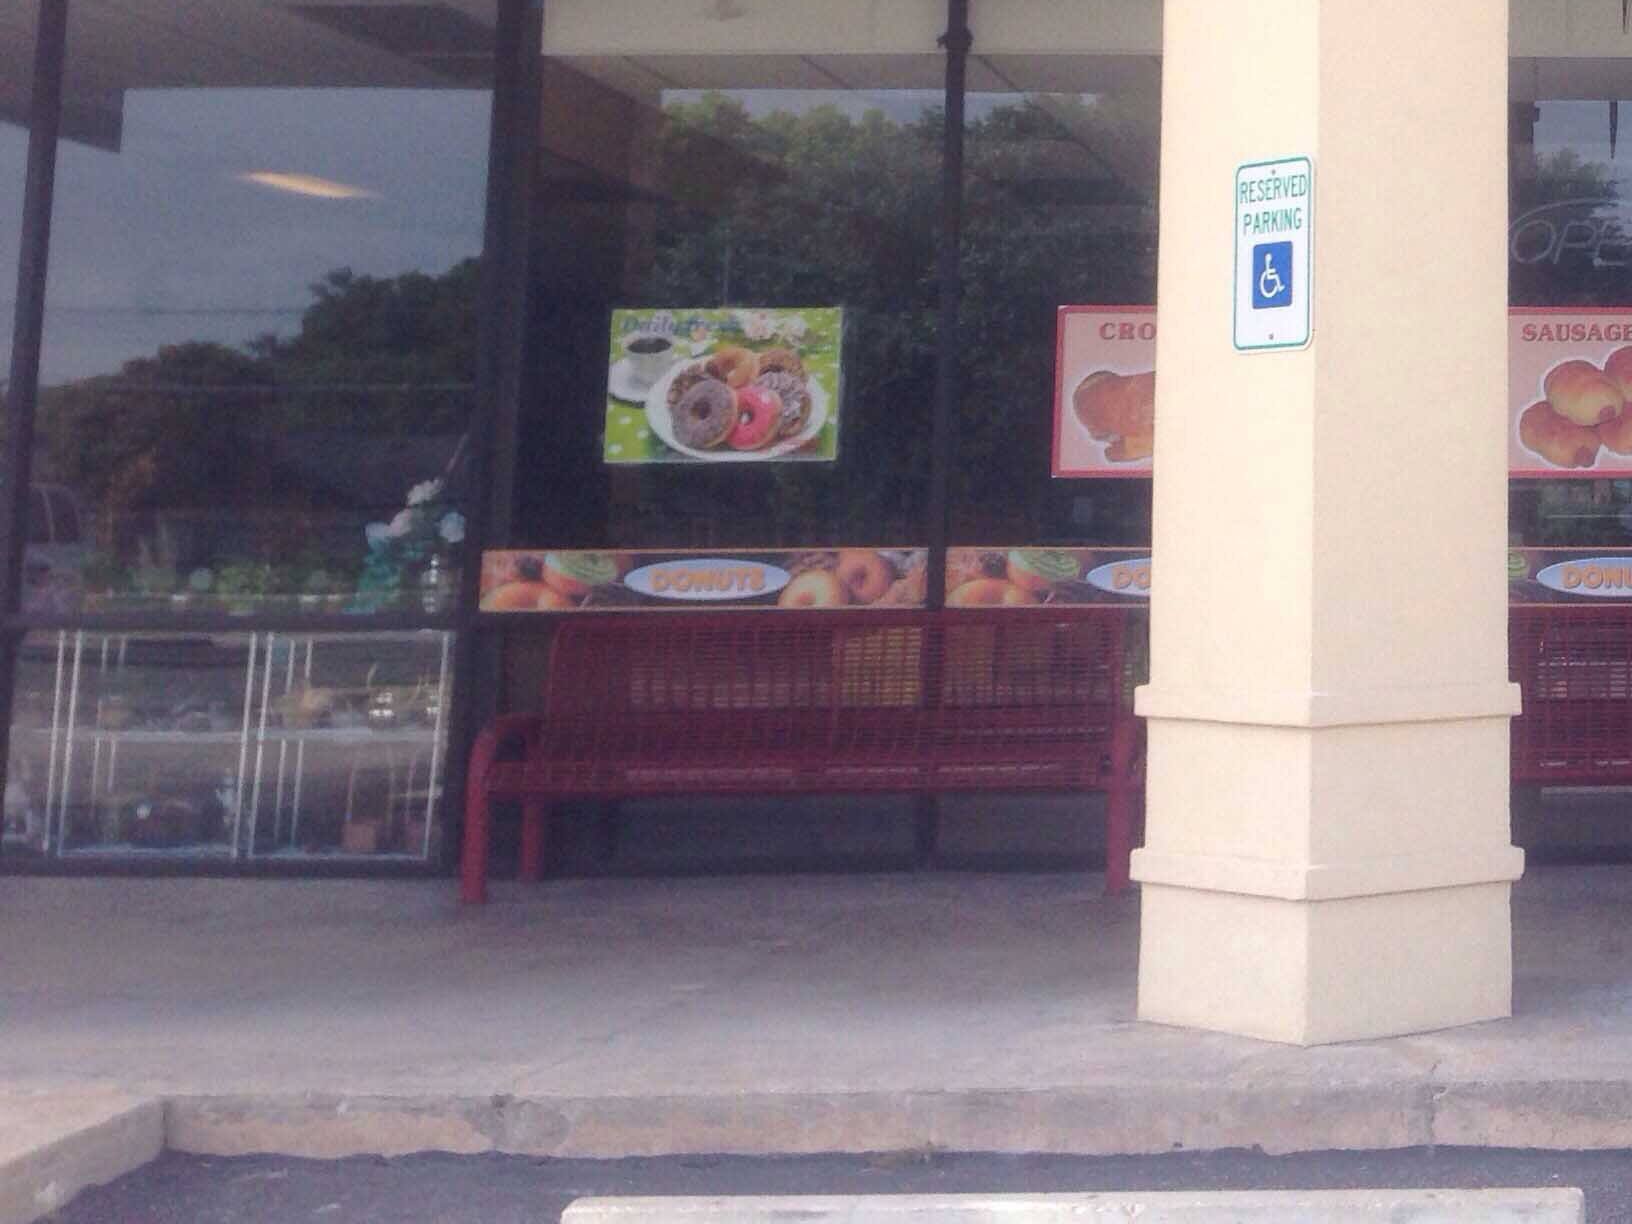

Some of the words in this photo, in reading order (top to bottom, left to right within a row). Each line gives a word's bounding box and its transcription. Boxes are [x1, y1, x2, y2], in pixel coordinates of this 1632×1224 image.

[1239, 174, 1308, 204] RESERVED
[1243, 207, 1303, 235] PARKING
[652, 566, 766, 592] DONUTS
